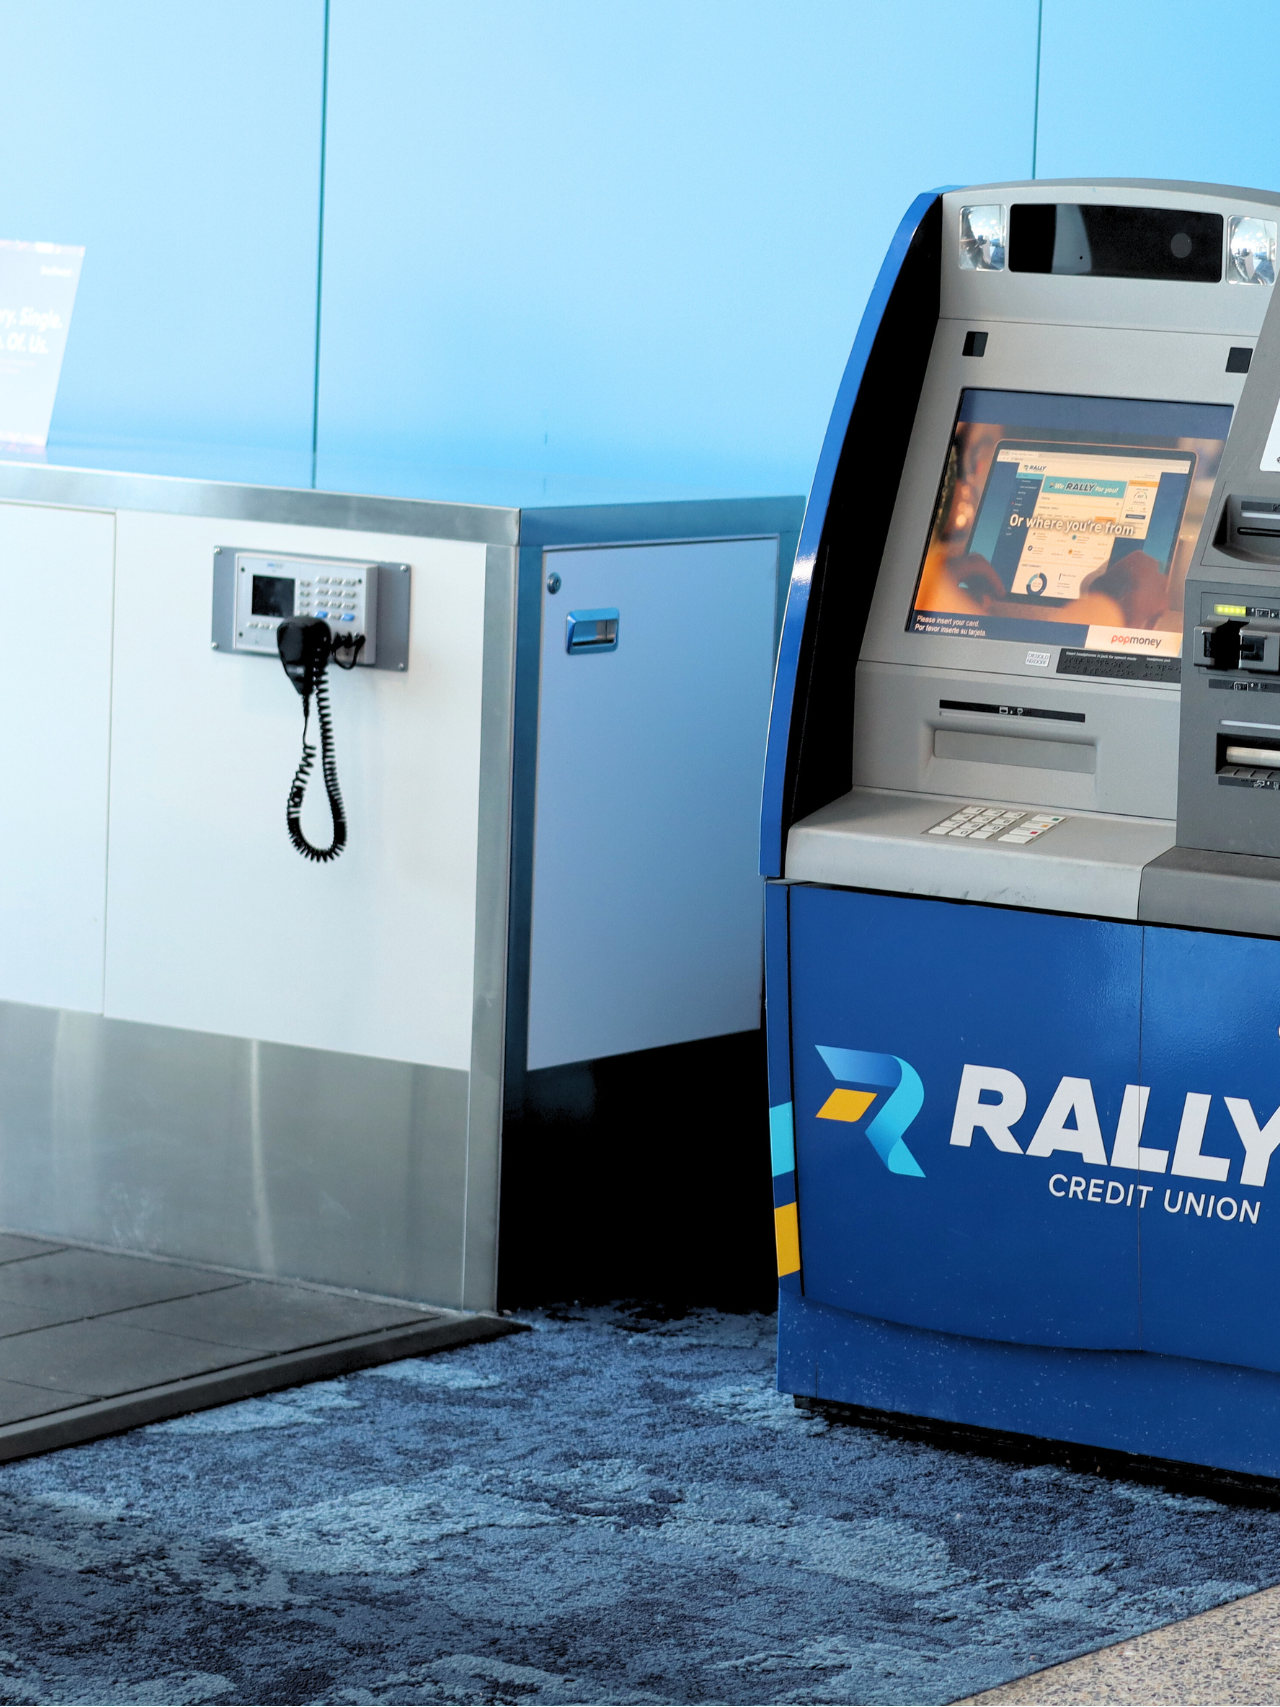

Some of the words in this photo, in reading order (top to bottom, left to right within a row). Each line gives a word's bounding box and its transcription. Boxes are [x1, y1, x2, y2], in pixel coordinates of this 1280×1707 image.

[1065, 482, 1095, 492] RALLY
[1010, 513, 1024, 527] Or
[1026, 516, 1063, 530] where
[1104, 521, 1135, 536] from
[916, 614, 936, 623] Please
[936, 616, 952, 625] insert
[925, 624, 941, 632] favor
[940, 625, 960, 634] inserte
[1111, 634, 1162, 649] popmoney
[1047, 1172, 1154, 1210] CREDIT
[1163, 1189, 1262, 1225] UNION
